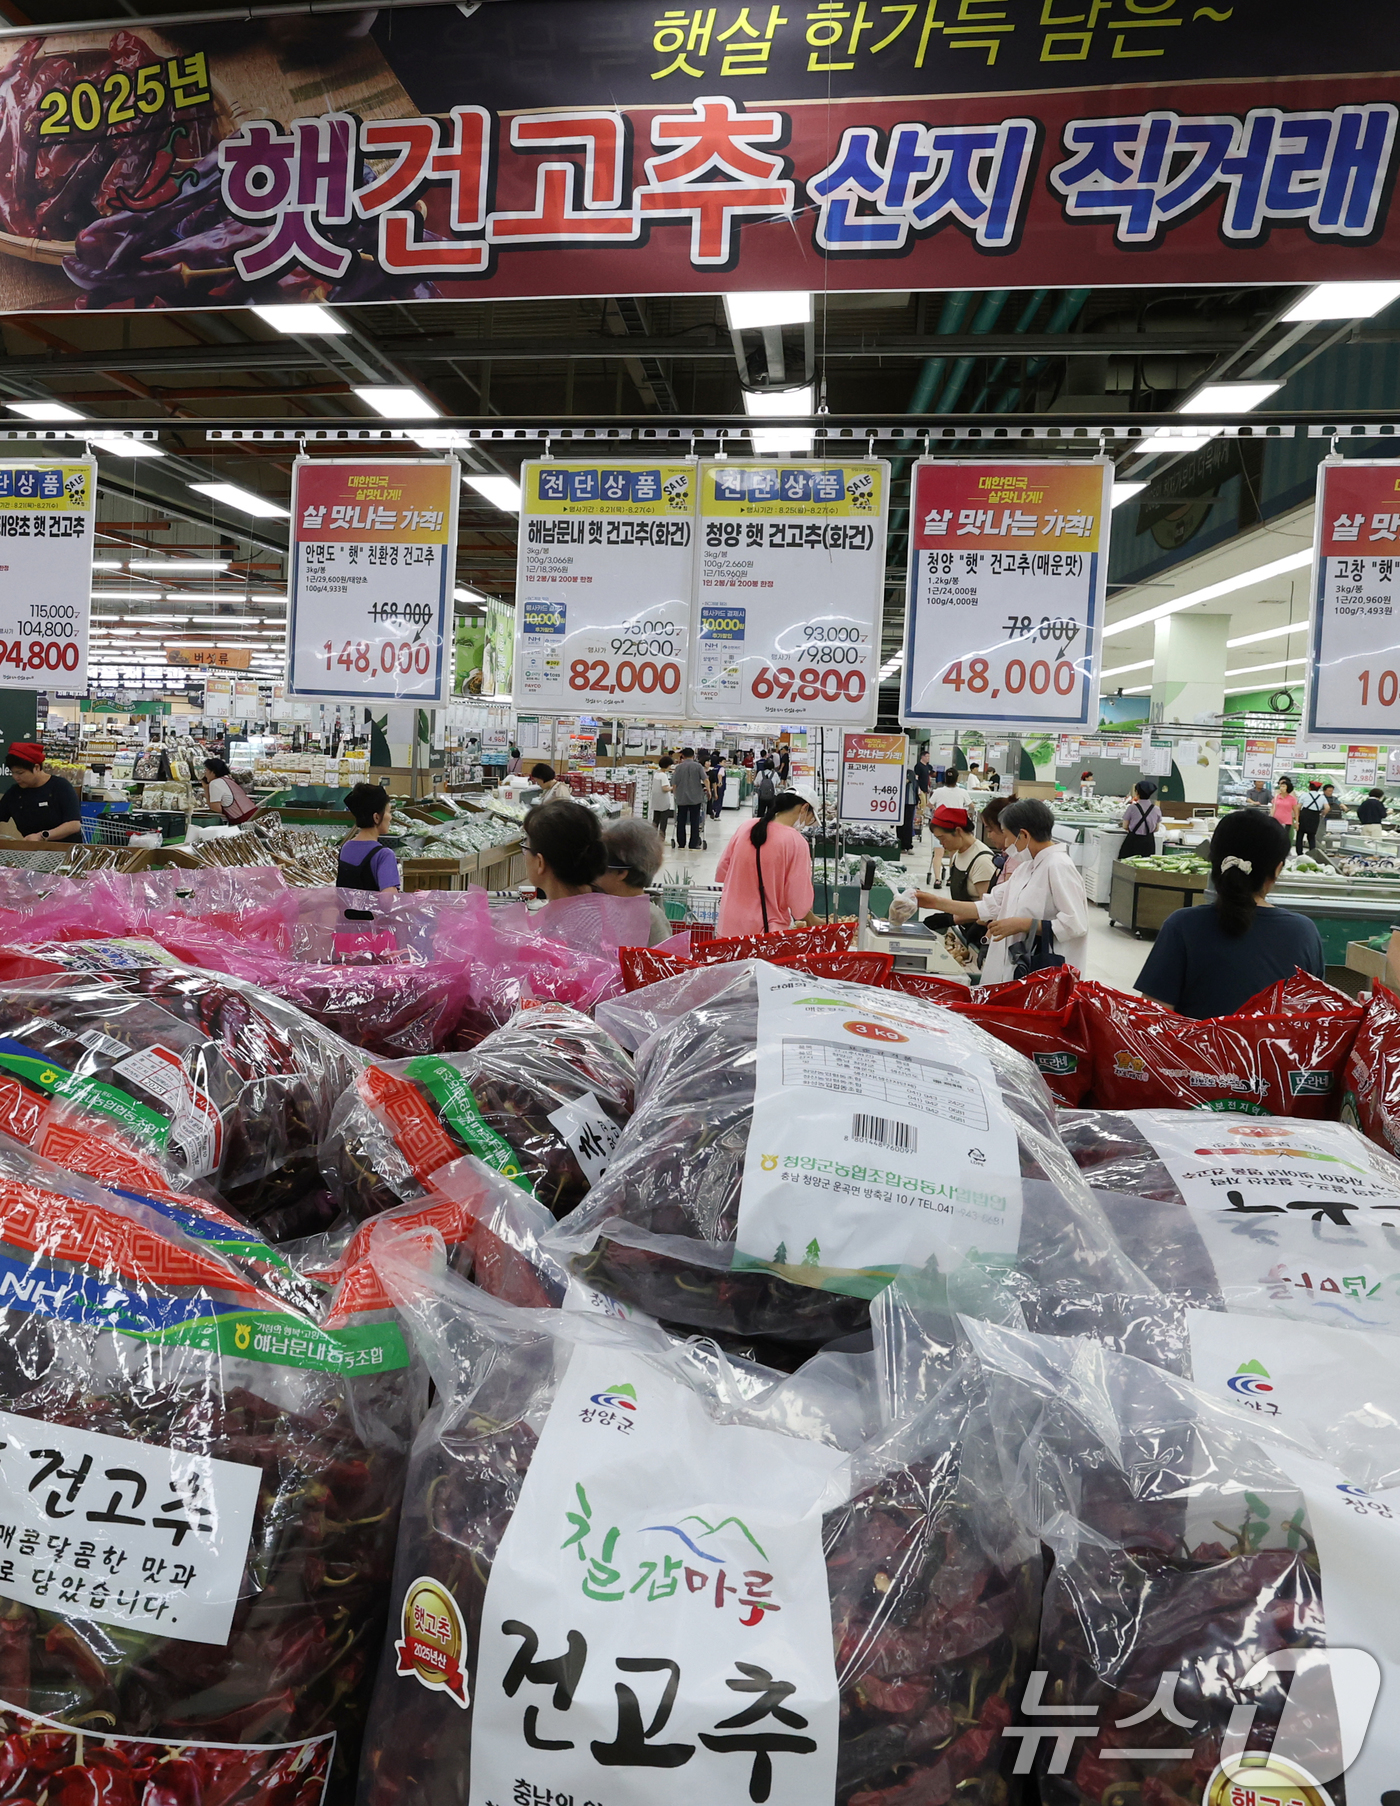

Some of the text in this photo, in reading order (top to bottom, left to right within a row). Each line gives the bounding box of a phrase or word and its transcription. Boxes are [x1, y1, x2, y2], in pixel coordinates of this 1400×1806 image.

[651, 4, 788, 81] 햇살
[804, 0, 1019, 72] 한가득
[39, 51, 211, 136] 2025년
[806, 118, 1037, 251] 산지
[1050, 103, 1399, 243] 직거래
[65, 474, 84, 493] SALE
[348, 476, 389, 487] 대한민국
[663, 474, 688, 496] SALE
[846, 474, 872, 496] SALE
[978, 477, 1028, 489] 대한민국
[356, 489, 402, 500] 살맛나게!
[988, 491, 1044, 504] 살맛나게!
[34, 516, 85, 538] 햇 건고추
[302, 505, 444, 531] 살 맛나는 가격!
[923, 509, 1094, 538] 살 맛나는 가격!
[1332, 513, 1366, 542] 살
[528, 520, 691, 547] 해남문내 햇 건고추(화건)
[706, 522, 874, 550] 청양 햇 건고추(화건)
[305, 544, 435, 567] 안면도 친환경 건고추
[526, 547, 550, 555] 3kg/봉
[305, 566, 326, 574] 3kg/봉
[927, 552, 954, 575] 청양
[990, 553, 1083, 577] 건고추(매운맛)
[1334, 560, 1365, 582] 고창
[305, 585, 348, 593] 100g/4,933원
[927, 587, 977, 596] 1근/24,000원
[928, 577, 960, 586] 1.2kg/봉
[1335, 585, 1363, 594] 3kg/봉
[926, 597, 979, 606] 100g/4,000원
[1334, 606, 1393, 616] 100g/3,493원
[1335, 596, 1391, 605] 1근/20,960원
[30, 605, 74, 619] 115,000
[372, 602, 431, 627] 168,000
[18, 620, 73, 638] 104,800
[621, 620, 675, 636] 95,000
[803, 626, 860, 643] 93,000
[1007, 615, 1077, 643] 78,000
[194, 652, 229, 664] 버섯류
[323, 640, 430, 677] 148,000
[611, 638, 673, 658] 92,000
[795, 645, 859, 665] 79,800
[569, 659, 681, 694] 82,000
[751, 667, 866, 703] 69,800
[942, 657, 1075, 699] 48,000
[846, 749, 856, 758] 살
[847, 763, 876, 772] 표고버섯
[873, 785, 898, 795] 1,480
[870, 799, 897, 813] 990
[854, 1024, 901, 1042] 3 kg
[144, 1079, 165, 1094] 2025
[780, 1172, 800, 1183] 충남
[802, 1174, 831, 1190] 청양군
[832, 1181, 861, 1197] 운곡면
[863, 1188, 893, 1203] 방축길
[895, 1193, 908, 1205] 10
[0, 1271, 68, 1307] NH
[578, 1408, 635, 1436] 청양군
[28, 1447, 213, 1546] 건고추
[141, 1555, 197, 1590] 맛과
[31, 1567, 178, 1624] 담았습니다.
[413, 1604, 452, 1644] 햇고추
[413, 1641, 446, 1669] 2025년산
[502, 1620, 817, 1804] 건고추
